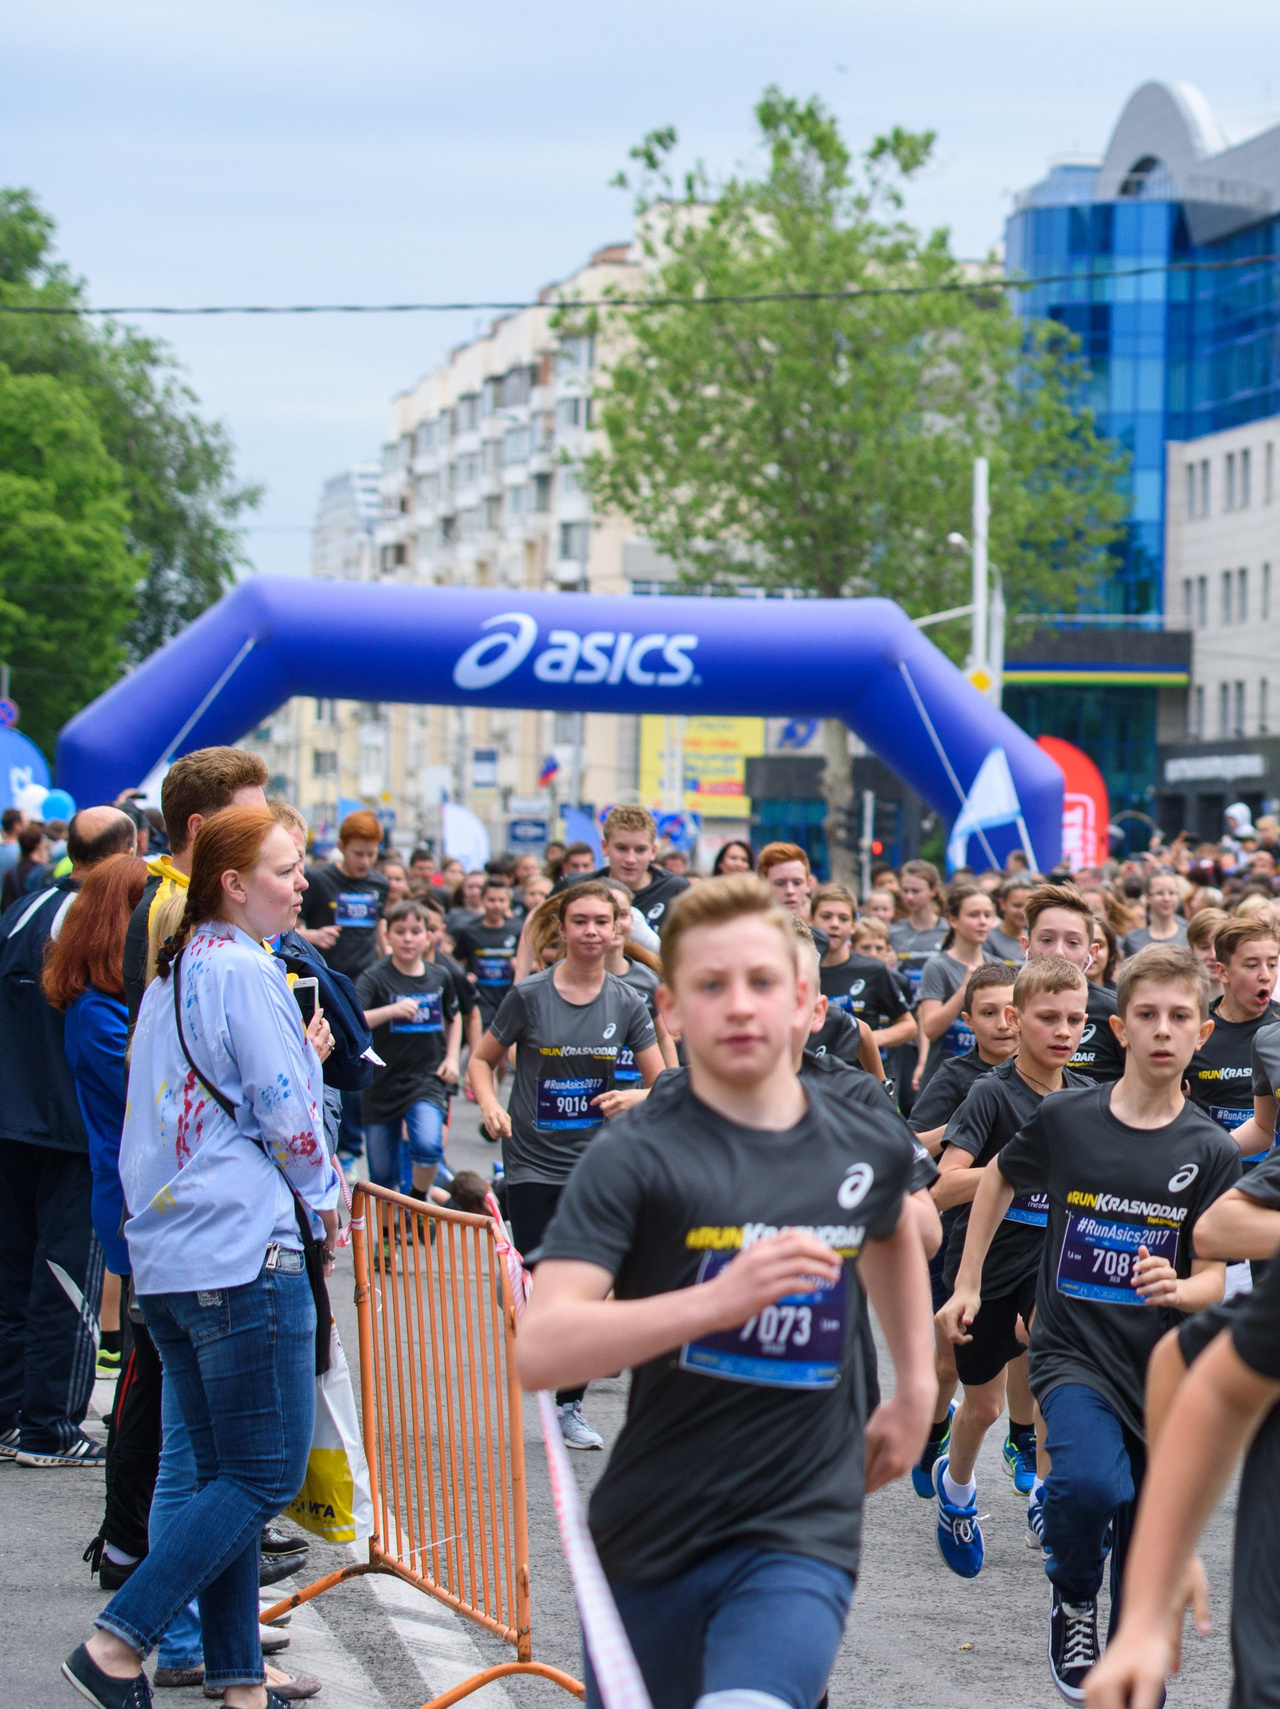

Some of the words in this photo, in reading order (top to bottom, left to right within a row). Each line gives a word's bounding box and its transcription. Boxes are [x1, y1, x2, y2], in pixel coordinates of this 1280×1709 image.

[616, 1049, 634, 1065] 22
[557, 1096, 588, 1113] 9016
[1067, 1190, 1188, 1221] #RUNKRASNODAR
[1077, 1217, 1170, 1245] #RunAsics2017
